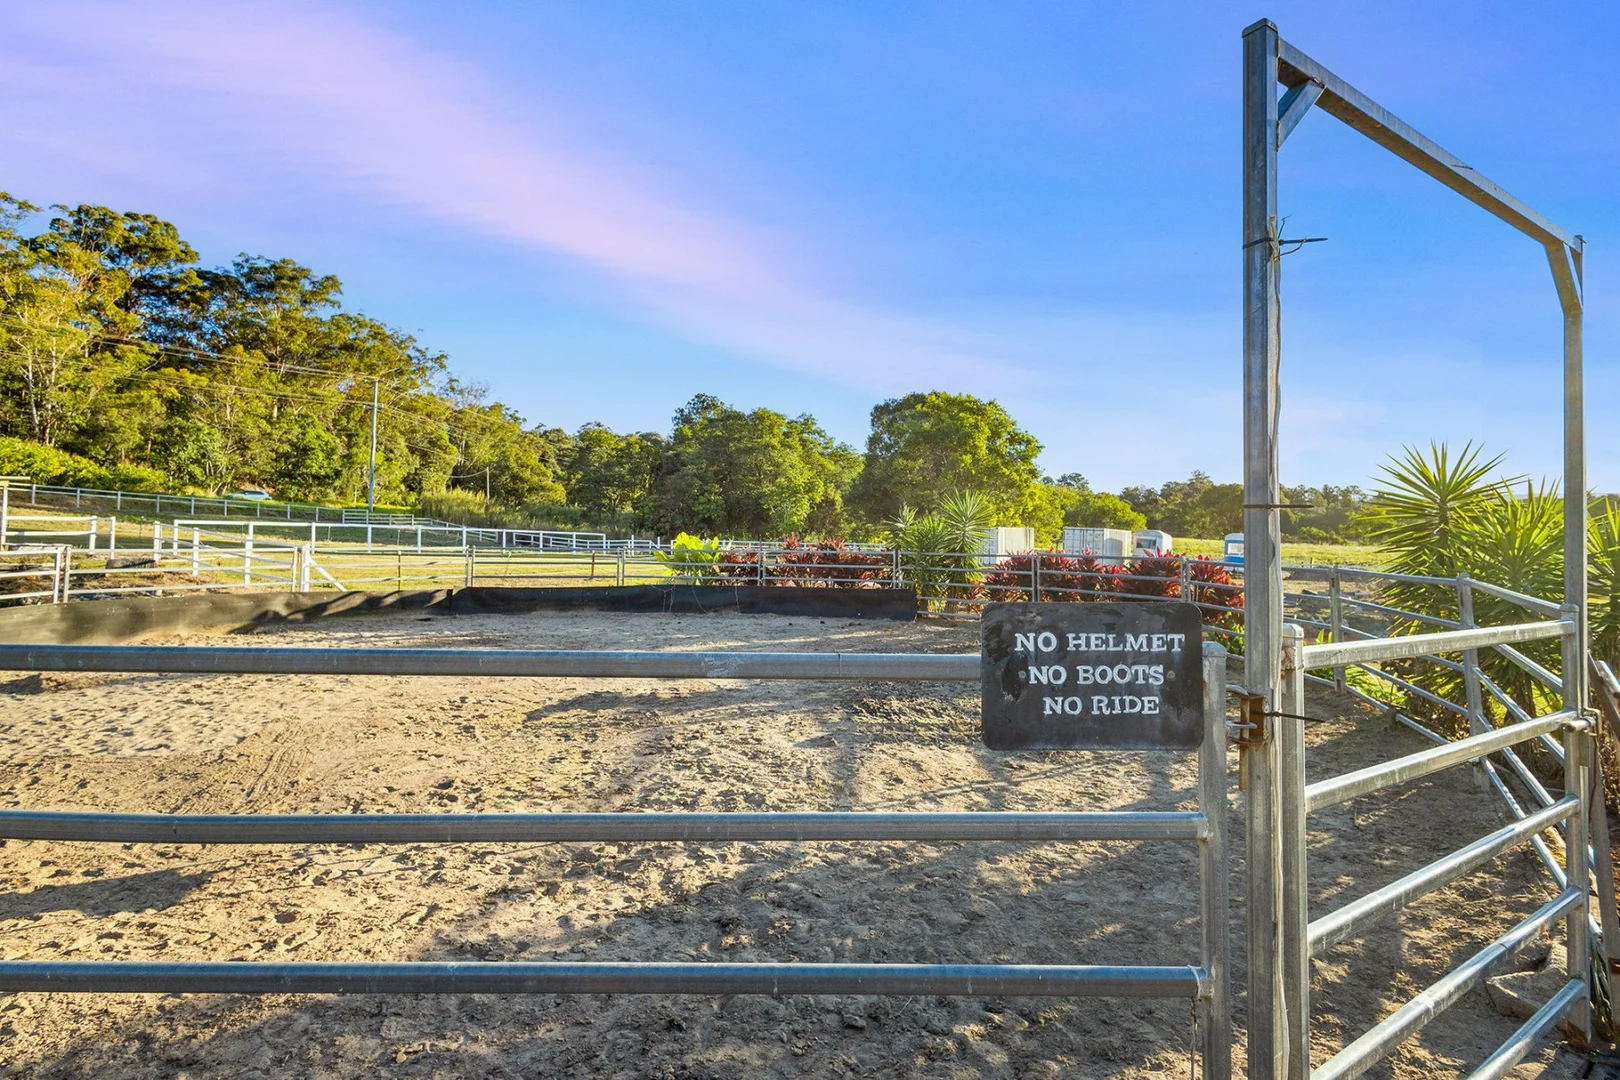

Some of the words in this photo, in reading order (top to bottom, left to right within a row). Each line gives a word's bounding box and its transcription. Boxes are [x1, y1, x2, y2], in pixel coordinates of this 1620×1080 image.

[1014, 631, 1057, 652] NO
[1066, 633, 1186, 652] HELMET
[1028, 665, 1067, 685] NO
[1076, 664, 1164, 686] BOOTS
[1043, 696, 1083, 715] NO
[1091, 695, 1160, 715] RIDE
